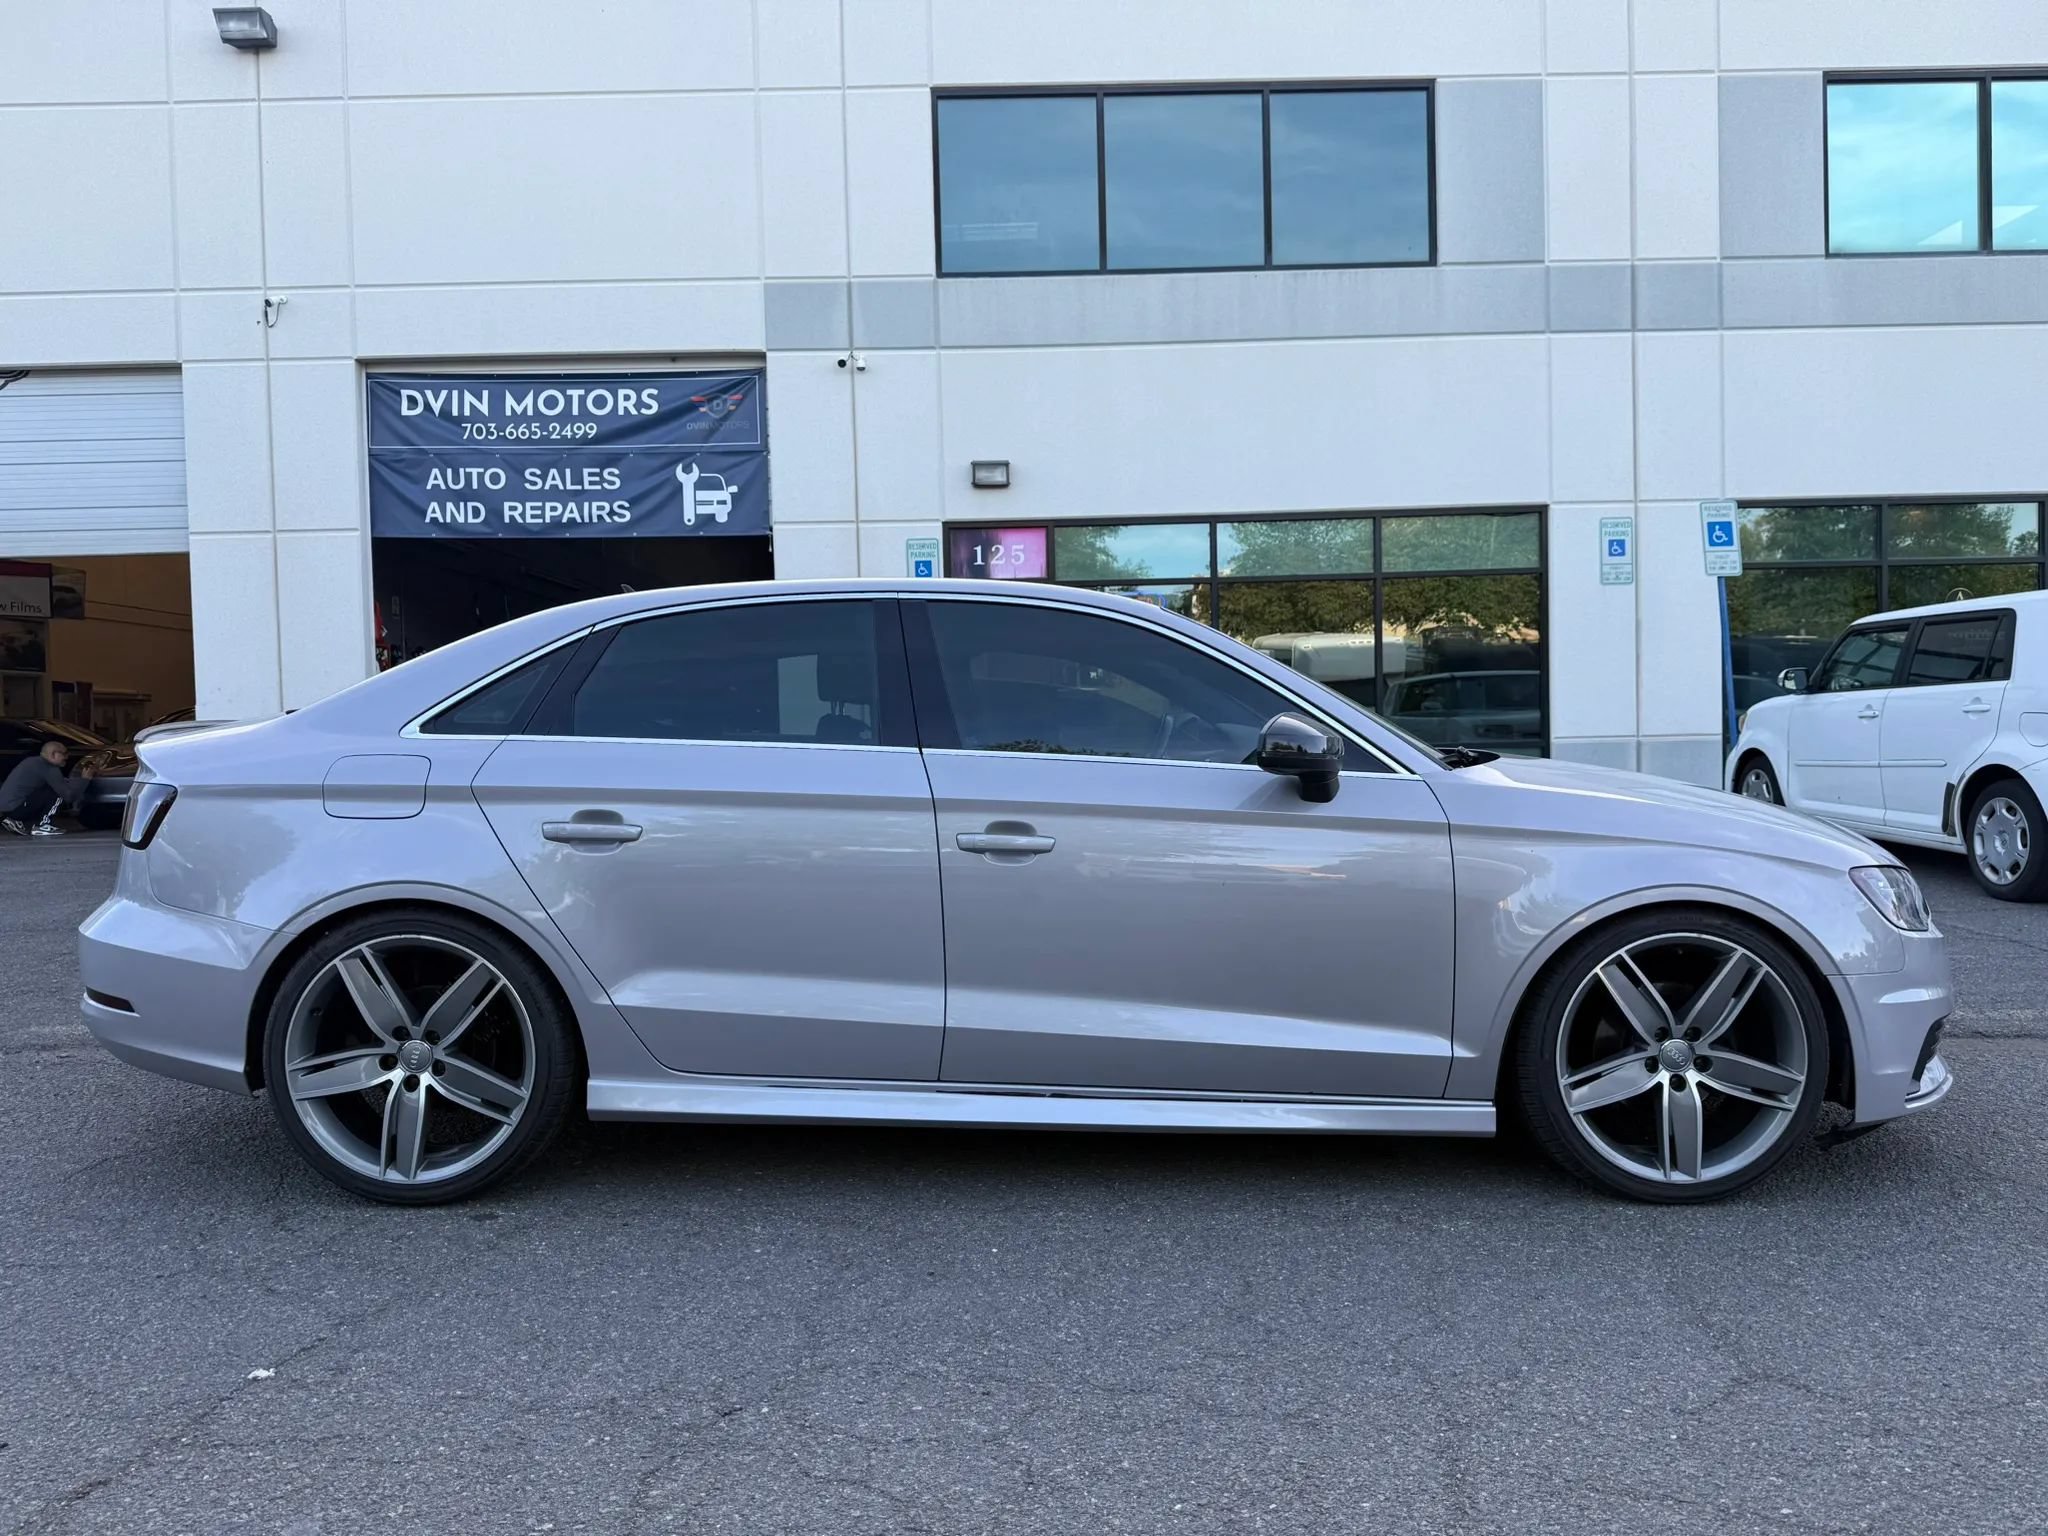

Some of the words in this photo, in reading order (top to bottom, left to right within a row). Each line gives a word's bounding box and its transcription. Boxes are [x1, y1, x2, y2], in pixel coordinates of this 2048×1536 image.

[400, 389, 489, 417] DVIN
[505, 388, 659, 417] MOTORS
[461, 422, 598, 440] 703-665-2499
[426, 467, 506, 490] AUTO
[524, 467, 621, 491] SALES
[424, 501, 486, 524] AND
[503, 500, 632, 524] REPAIRS
[910, 551, 936, 559] PARKING
[973, 544, 1025, 565] 125
[10, 601, 42, 613] Films
